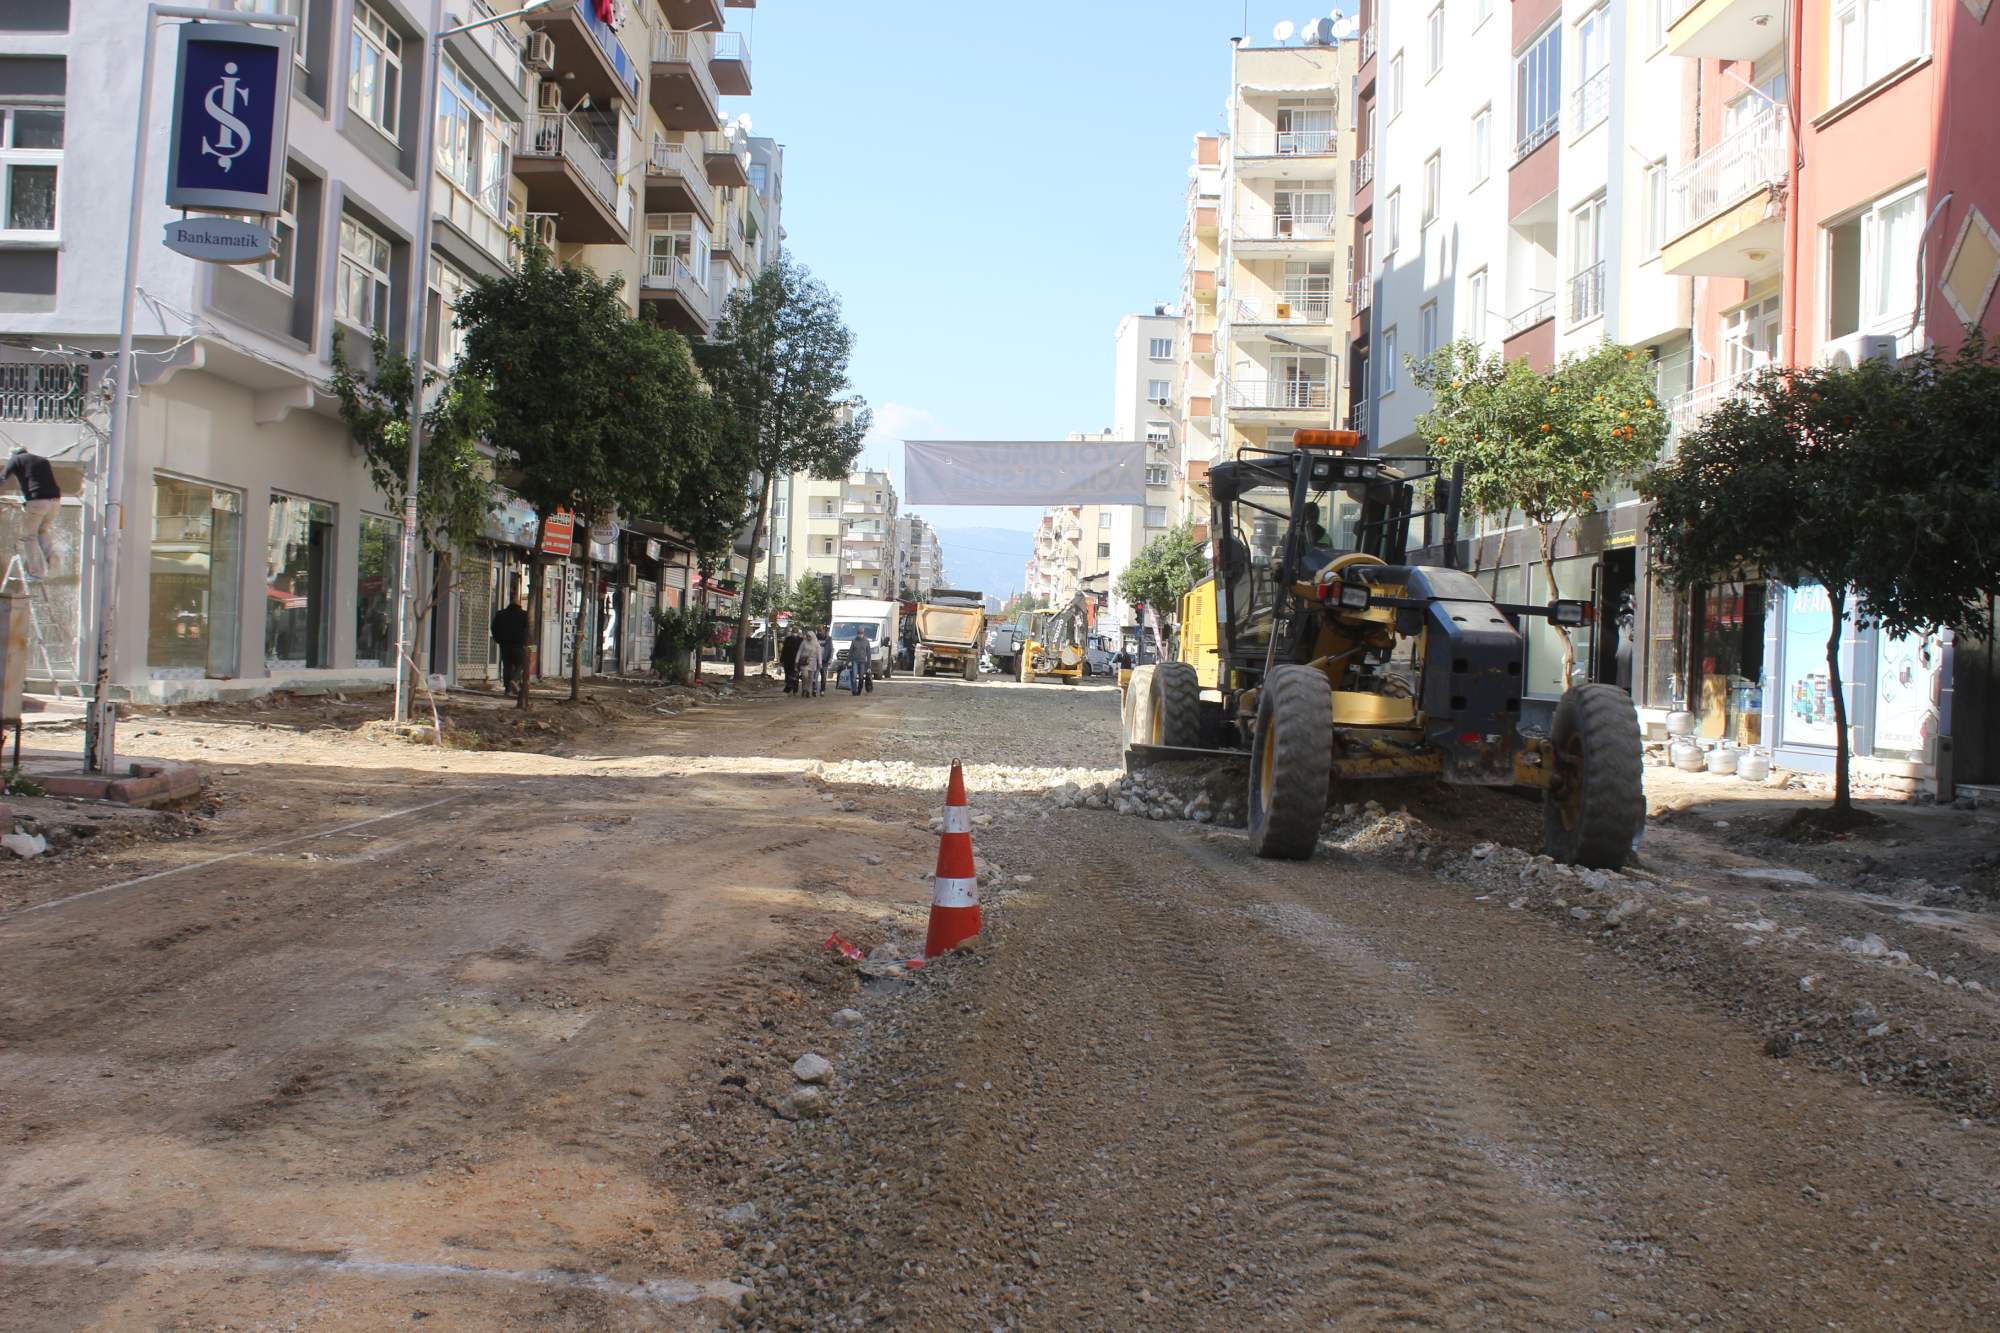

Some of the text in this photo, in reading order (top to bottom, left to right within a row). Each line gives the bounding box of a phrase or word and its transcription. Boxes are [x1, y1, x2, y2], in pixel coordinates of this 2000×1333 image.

[177, 229, 259, 248] Bankamatik
[563, 611, 573, 649] EMLAK
[1052, 619, 1064, 643] VOLVO
